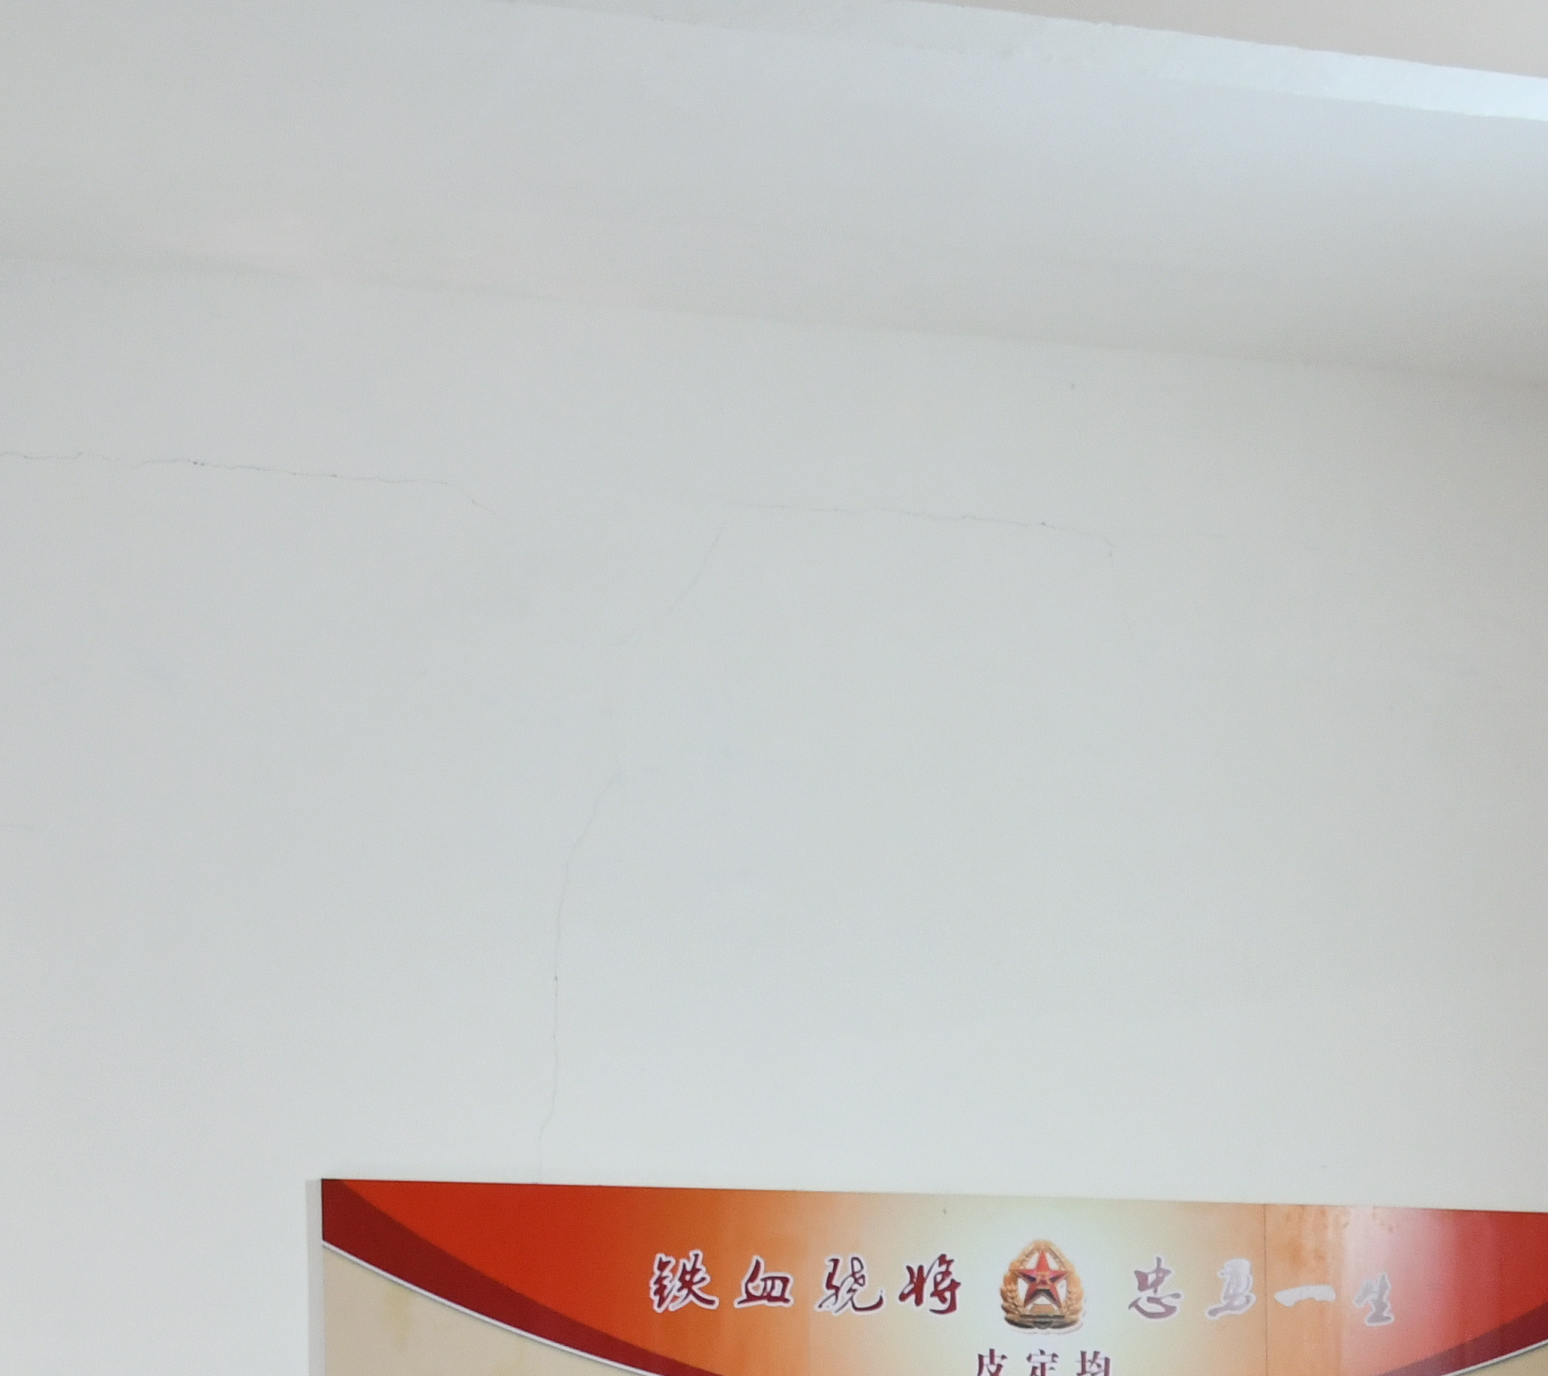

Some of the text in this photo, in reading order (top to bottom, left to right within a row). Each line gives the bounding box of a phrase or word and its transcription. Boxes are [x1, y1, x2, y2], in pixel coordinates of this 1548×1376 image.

[650, 1249, 1396, 1327] 铁血骁将 忠勇一生
